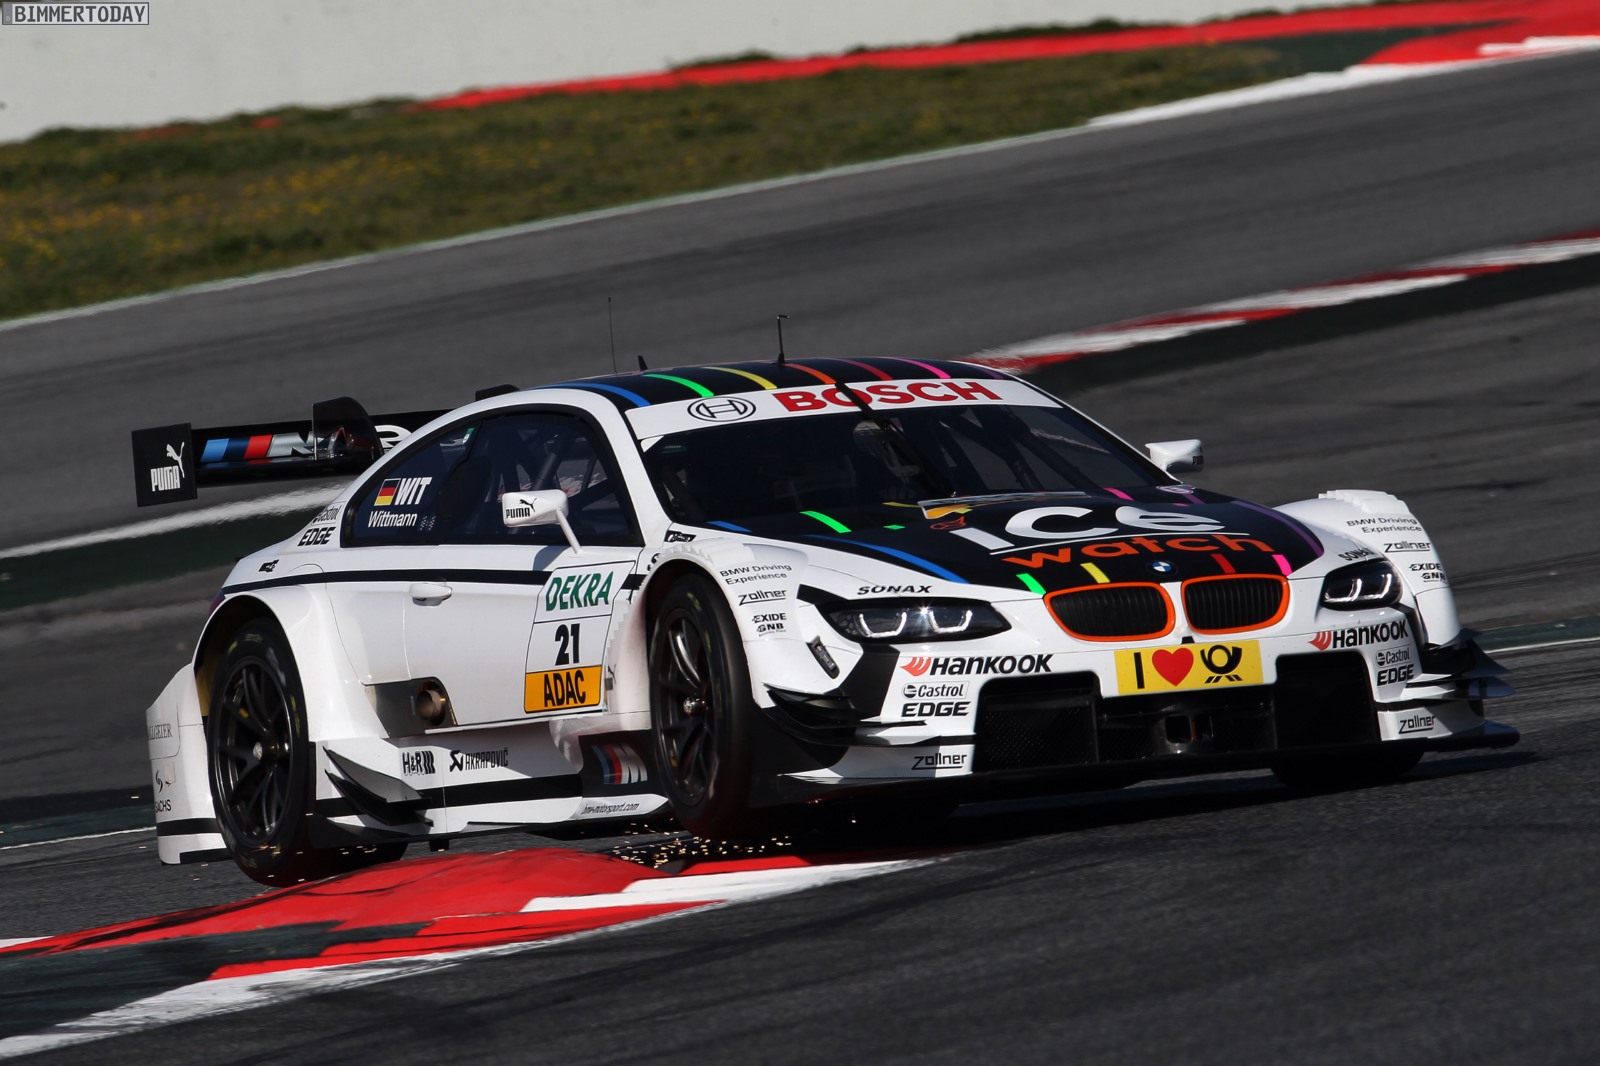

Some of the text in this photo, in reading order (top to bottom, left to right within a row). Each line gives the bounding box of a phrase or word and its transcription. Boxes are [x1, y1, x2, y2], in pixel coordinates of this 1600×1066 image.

[771, 382, 1004, 412] BOSCH
[151, 465, 181, 492] PUMA
[394, 477, 432, 505] WIT
[367, 511, 418, 528] Wittmann
[505, 507, 531, 519] PUMA
[1346, 516, 1418, 527] BMW Driving
[298, 526, 337, 546] EDGE
[1361, 525, 1423, 534] Experience
[1003, 534, 1275, 569] watch
[719, 564, 792, 577] BMW Driving
[1409, 562, 1442, 571] EXIDE
[725, 573, 788, 585] Experience
[546, 571, 614, 611] DEKRA
[857, 585, 932, 595] SONAX
[752, 612, 787, 623] EXIDE
[756, 623, 785, 633] GNB
[554, 623, 581, 666] 21
[1386, 647, 1410, 664] Castrol
[1376, 664, 1415, 686] EDGE
[544, 670, 586, 707] ADAC
[917, 683, 965, 698] Castrol
[901, 701, 972, 718] EDGE
